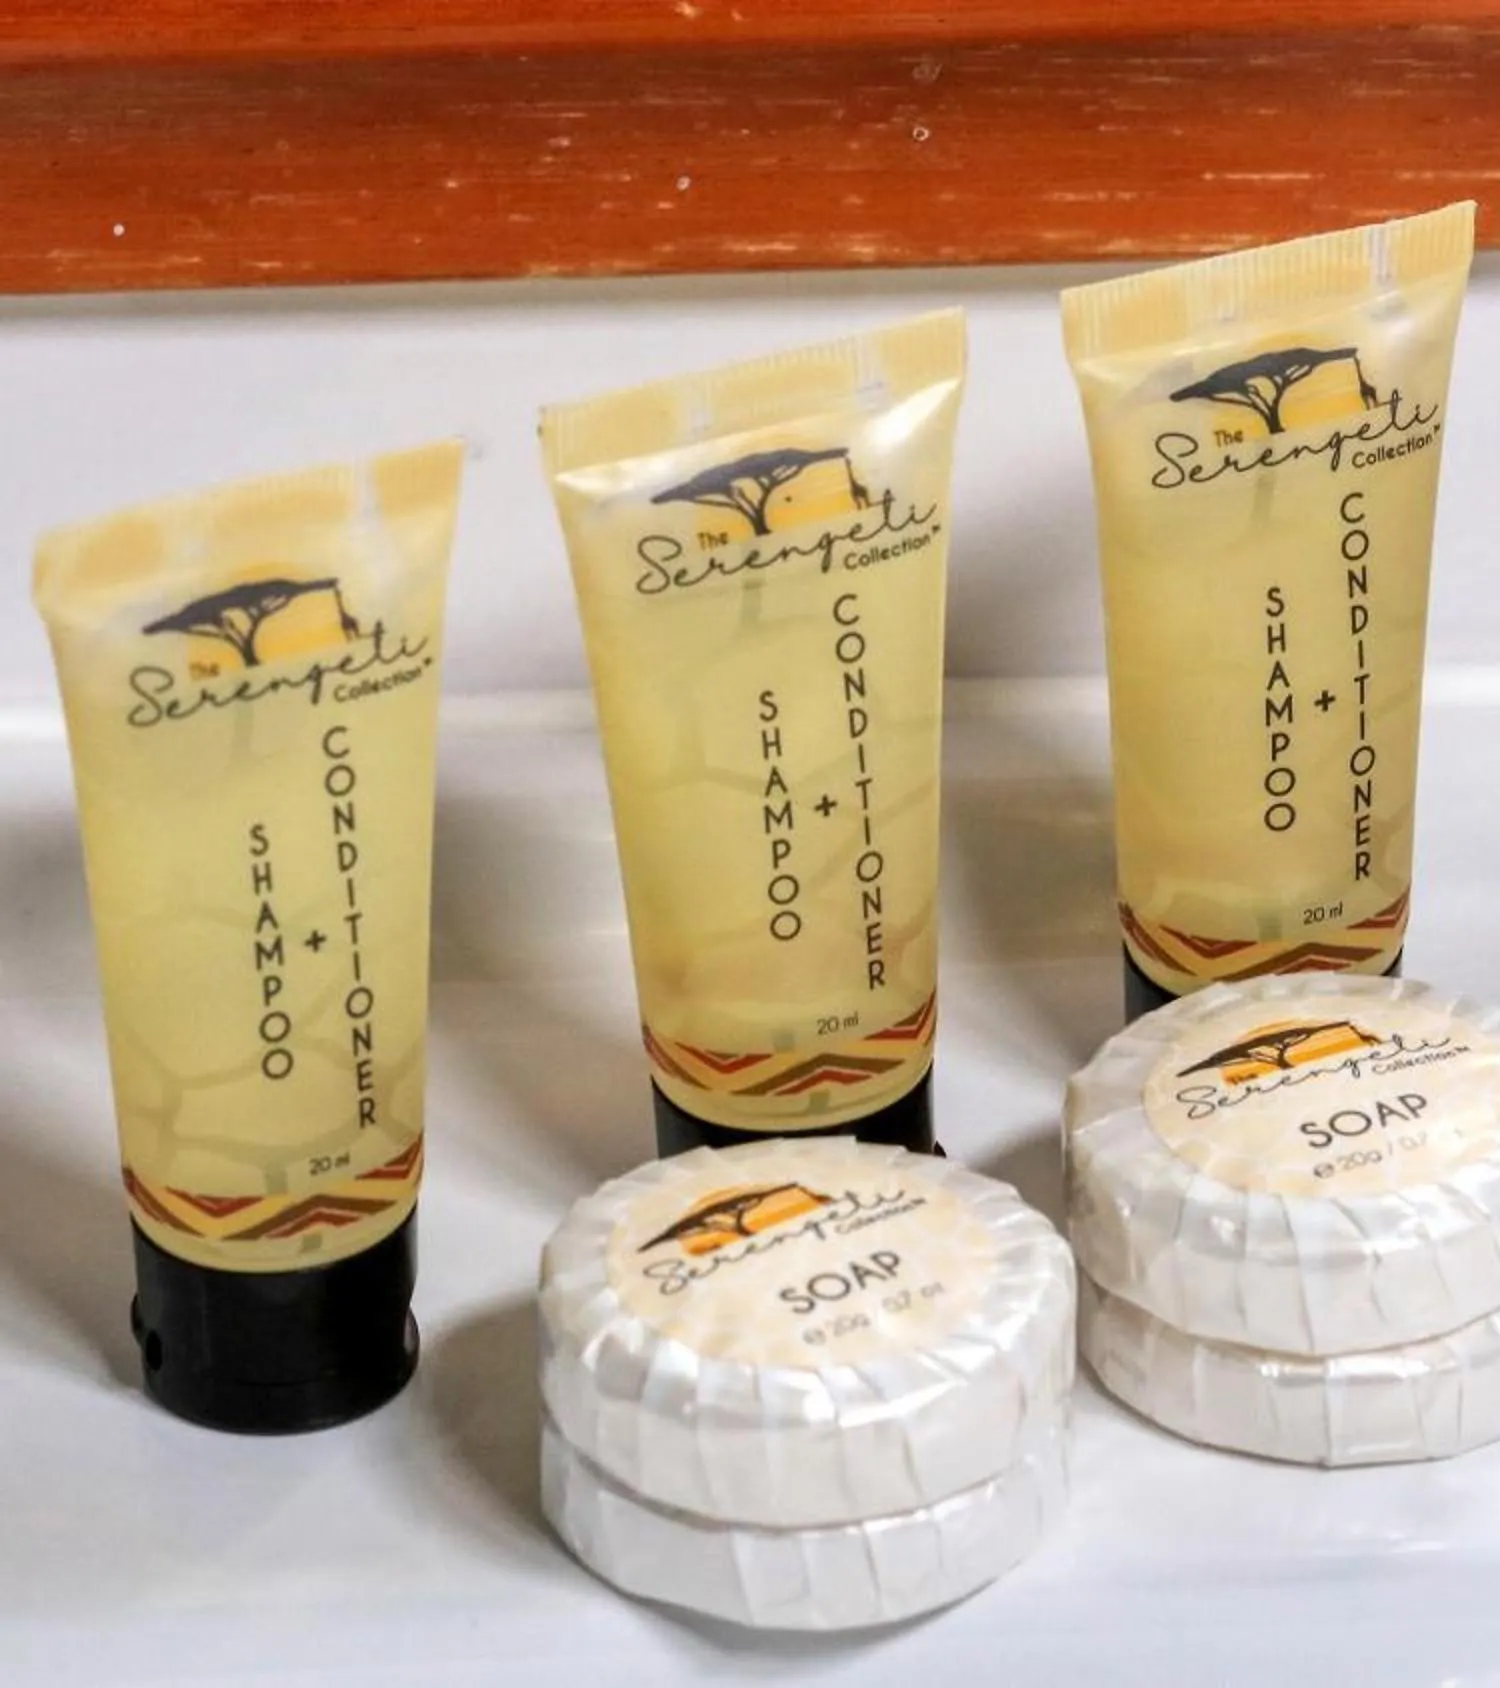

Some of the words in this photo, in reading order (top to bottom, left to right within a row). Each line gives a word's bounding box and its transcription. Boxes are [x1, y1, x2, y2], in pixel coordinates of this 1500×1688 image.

[1151, 389, 1438, 488] Serengeti
[1214, 429, 1244, 448] The
[636, 489, 937, 594] Serengeti
[697, 531, 729, 550] The
[127, 620, 429, 727] Serengeti
[1264, 586, 1296, 832] SHAMPOO
[1340, 492, 1375, 881] CONDITIONER
[759, 690, 801, 941] SHAMPOO
[833, 593, 885, 990] CONDITIONER
[250, 824, 294, 1080] SHAMPOO
[322, 725, 376, 1129] CONDITIONER
[1303, 907, 1325, 925] 20
[816, 1017, 839, 1035] 20
[1176, 1033, 1451, 1119] Serengeti
[309, 1156, 331, 1177] 20
[1299, 1093, 1428, 1148] SOAP
[643, 1189, 906, 1295] Serengeti
[780, 1251, 901, 1315] SOAP
